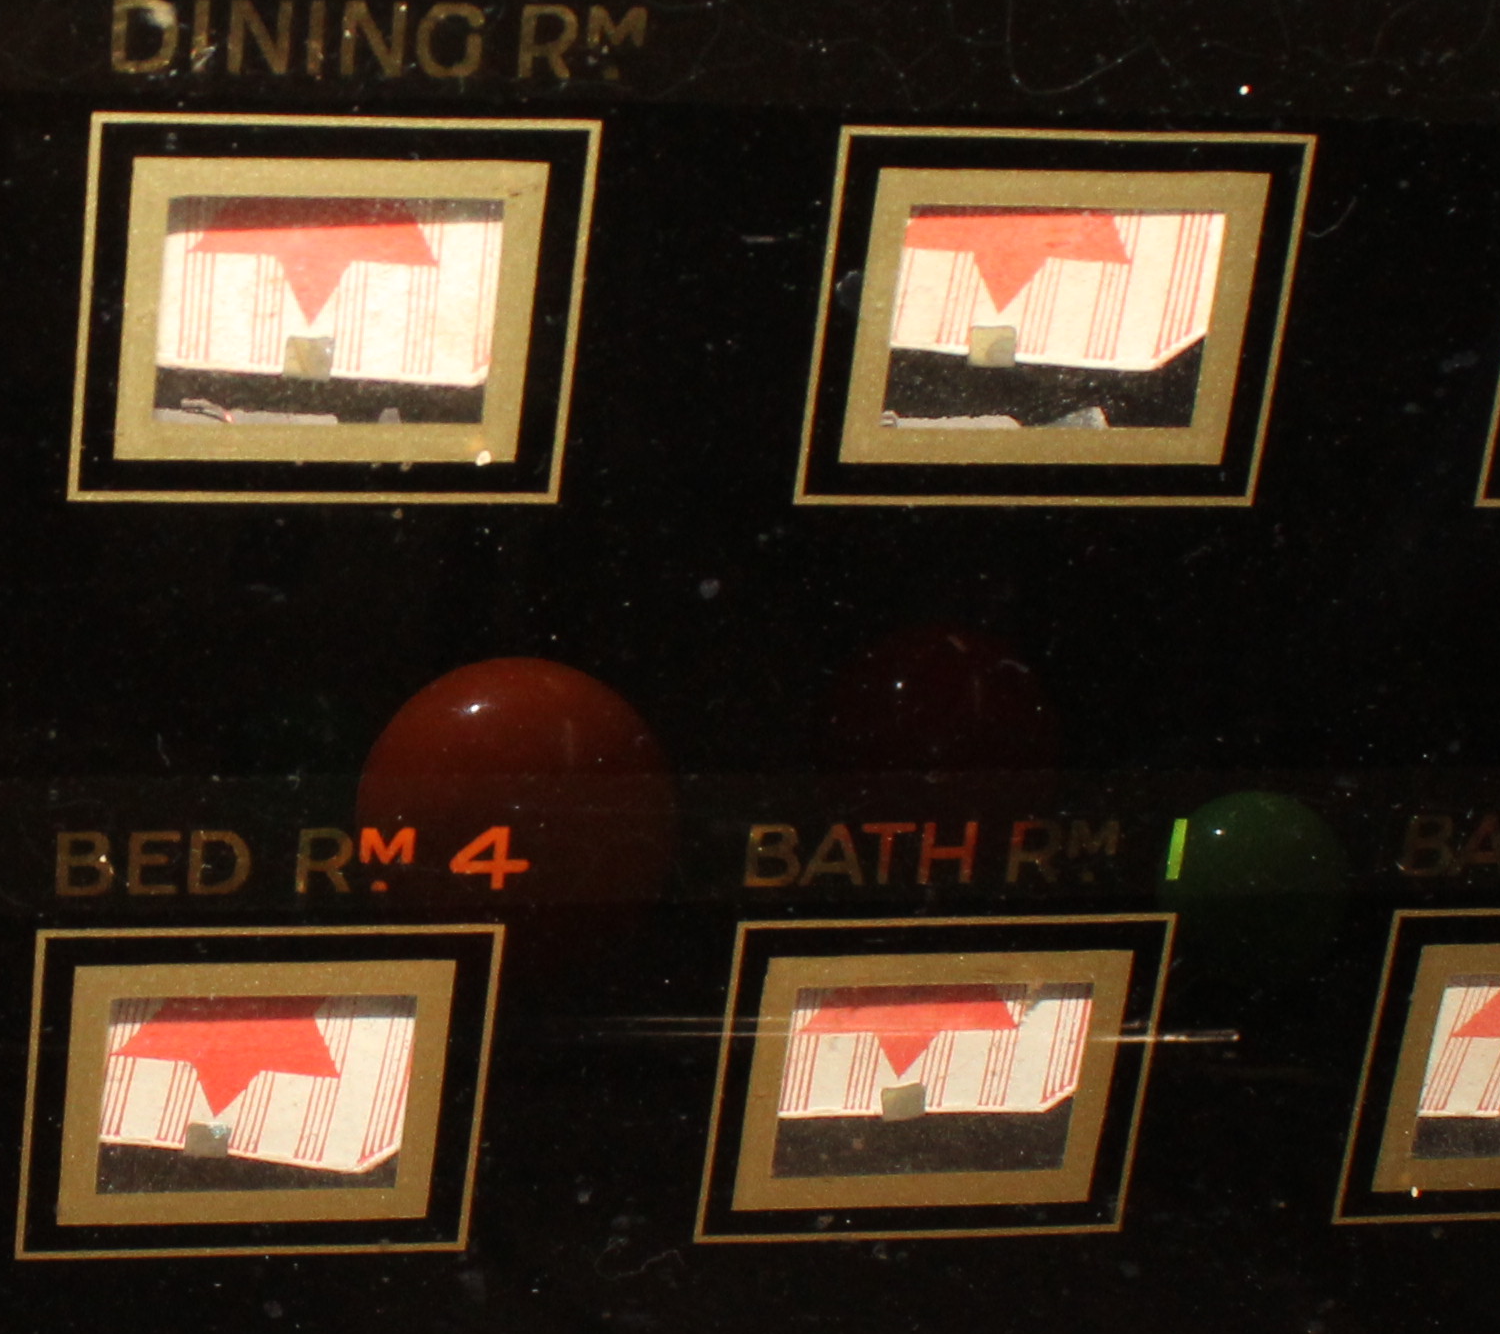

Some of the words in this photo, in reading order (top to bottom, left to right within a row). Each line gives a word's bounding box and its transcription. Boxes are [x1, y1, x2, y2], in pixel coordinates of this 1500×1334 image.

[55, 829, 254, 896] BED
[448, 825, 532, 890] 4
[742, 820, 980, 888] BATH
